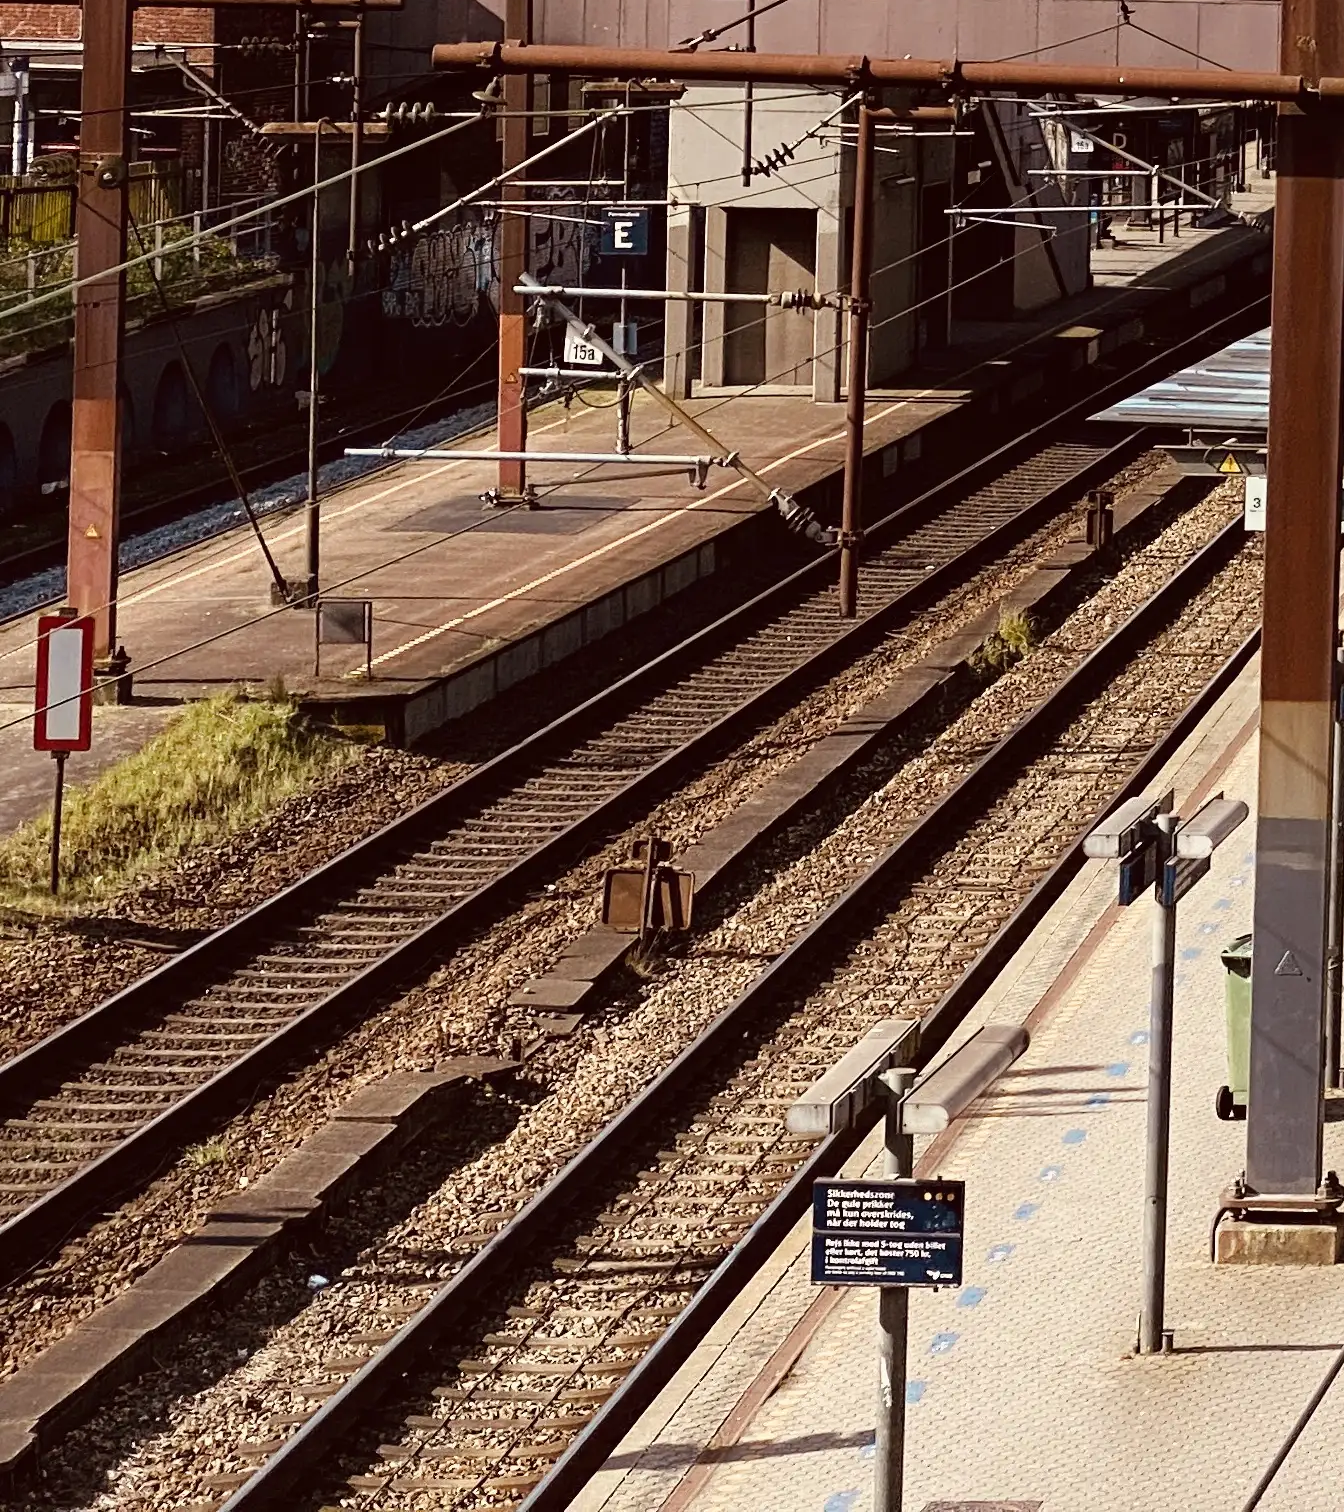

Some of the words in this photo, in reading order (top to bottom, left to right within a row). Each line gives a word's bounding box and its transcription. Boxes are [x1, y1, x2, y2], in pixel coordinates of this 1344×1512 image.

[614, 221, 633, 249] E
[573, 344, 595, 361] 15a
[1252, 497, 1261, 509] 3
[827, 1199, 839, 1208] De
[842, 1200, 861, 1209] gule
[862, 1200, 894, 1210] prikker
[826, 1209, 841, 1218] må
[842, 1209, 860, 1218] kun
[826, 1218, 842, 1227] når
[842, 1219, 858, 1227] der
[859, 1219, 889, 1228] holder
[889, 1221, 906, 1230] tog
[861, 1240, 879, 1248] med
[903, 1241, 924, 1249] uden
[864, 1249, 878, 1257] det
[904, 1250, 920, 1258] 750
